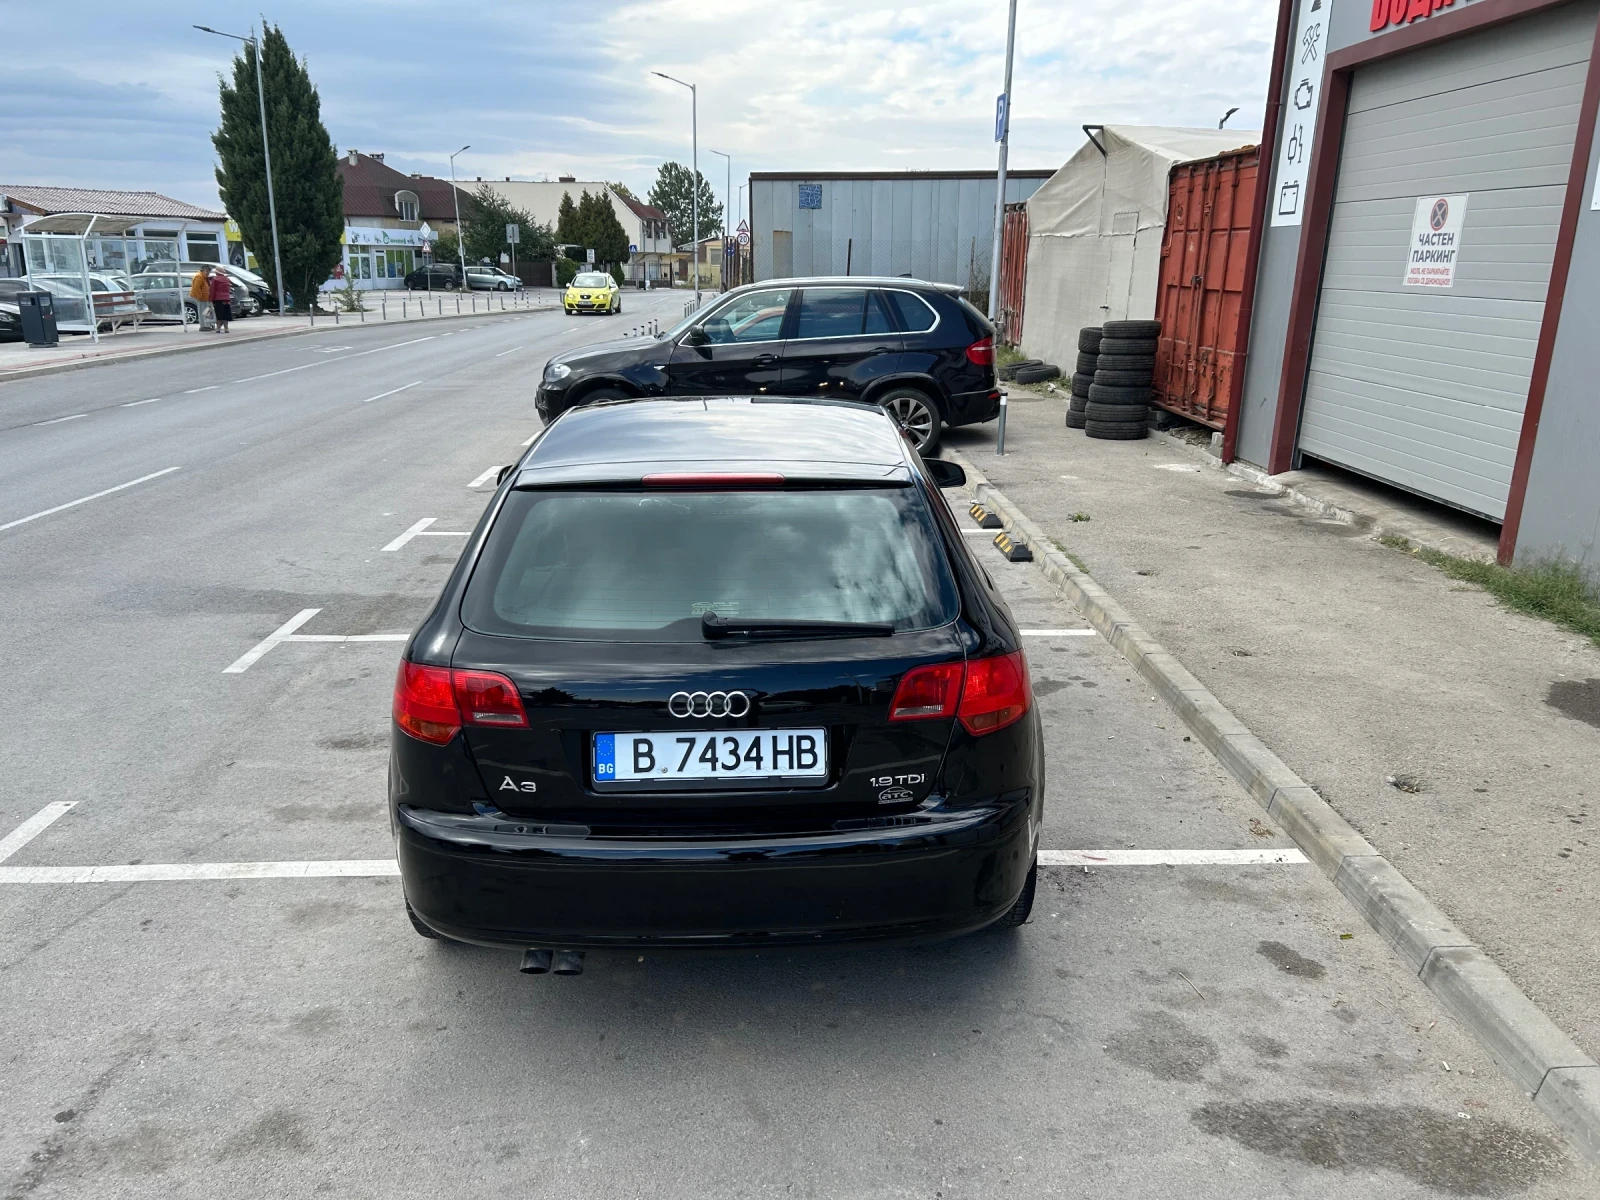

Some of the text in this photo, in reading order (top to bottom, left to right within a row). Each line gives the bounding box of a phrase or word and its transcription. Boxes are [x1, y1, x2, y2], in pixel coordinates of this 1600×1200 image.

[996, 99, 1004, 136] P
[1418, 232, 1454, 246] ЧАСТЕН
[1412, 250, 1455, 263] ПАРКИНГ
[632, 737, 657, 774] B
[598, 763, 614, 775] BG
[498, 775, 537, 793] A3
[869, 776, 893, 787] 1.9
